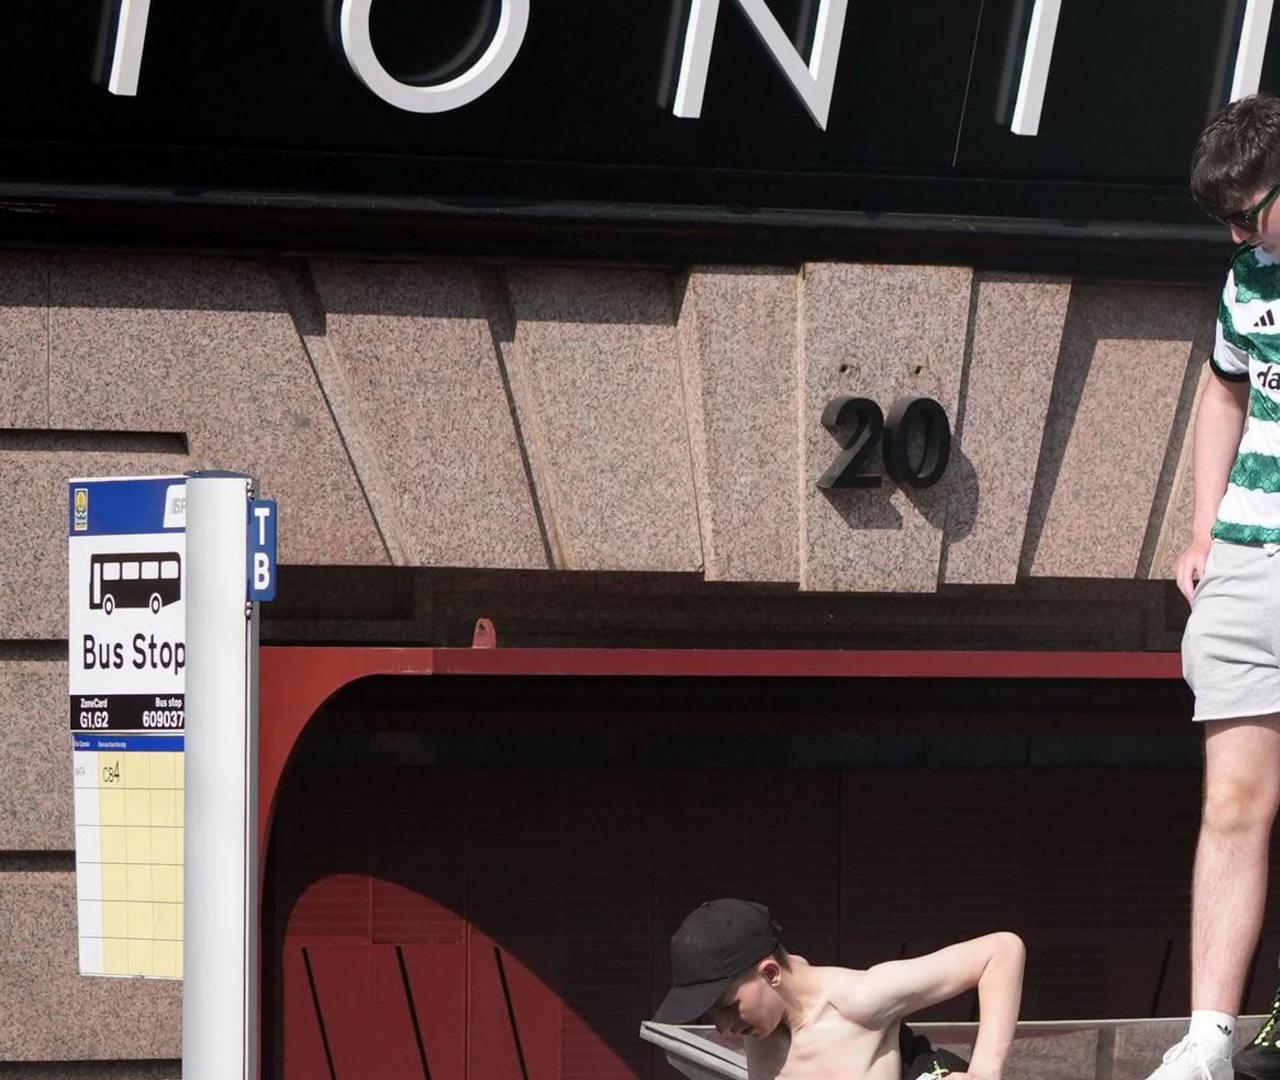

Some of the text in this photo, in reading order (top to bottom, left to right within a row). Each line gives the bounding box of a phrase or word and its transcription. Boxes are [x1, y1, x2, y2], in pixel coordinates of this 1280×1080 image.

[816, 397, 951, 489] 20
[83, 633, 186, 676] Bus Stop
[155, 697, 183, 709] Bus stop
[79, 711, 109, 729] G1,G2
[142, 710, 185, 728] 609037
